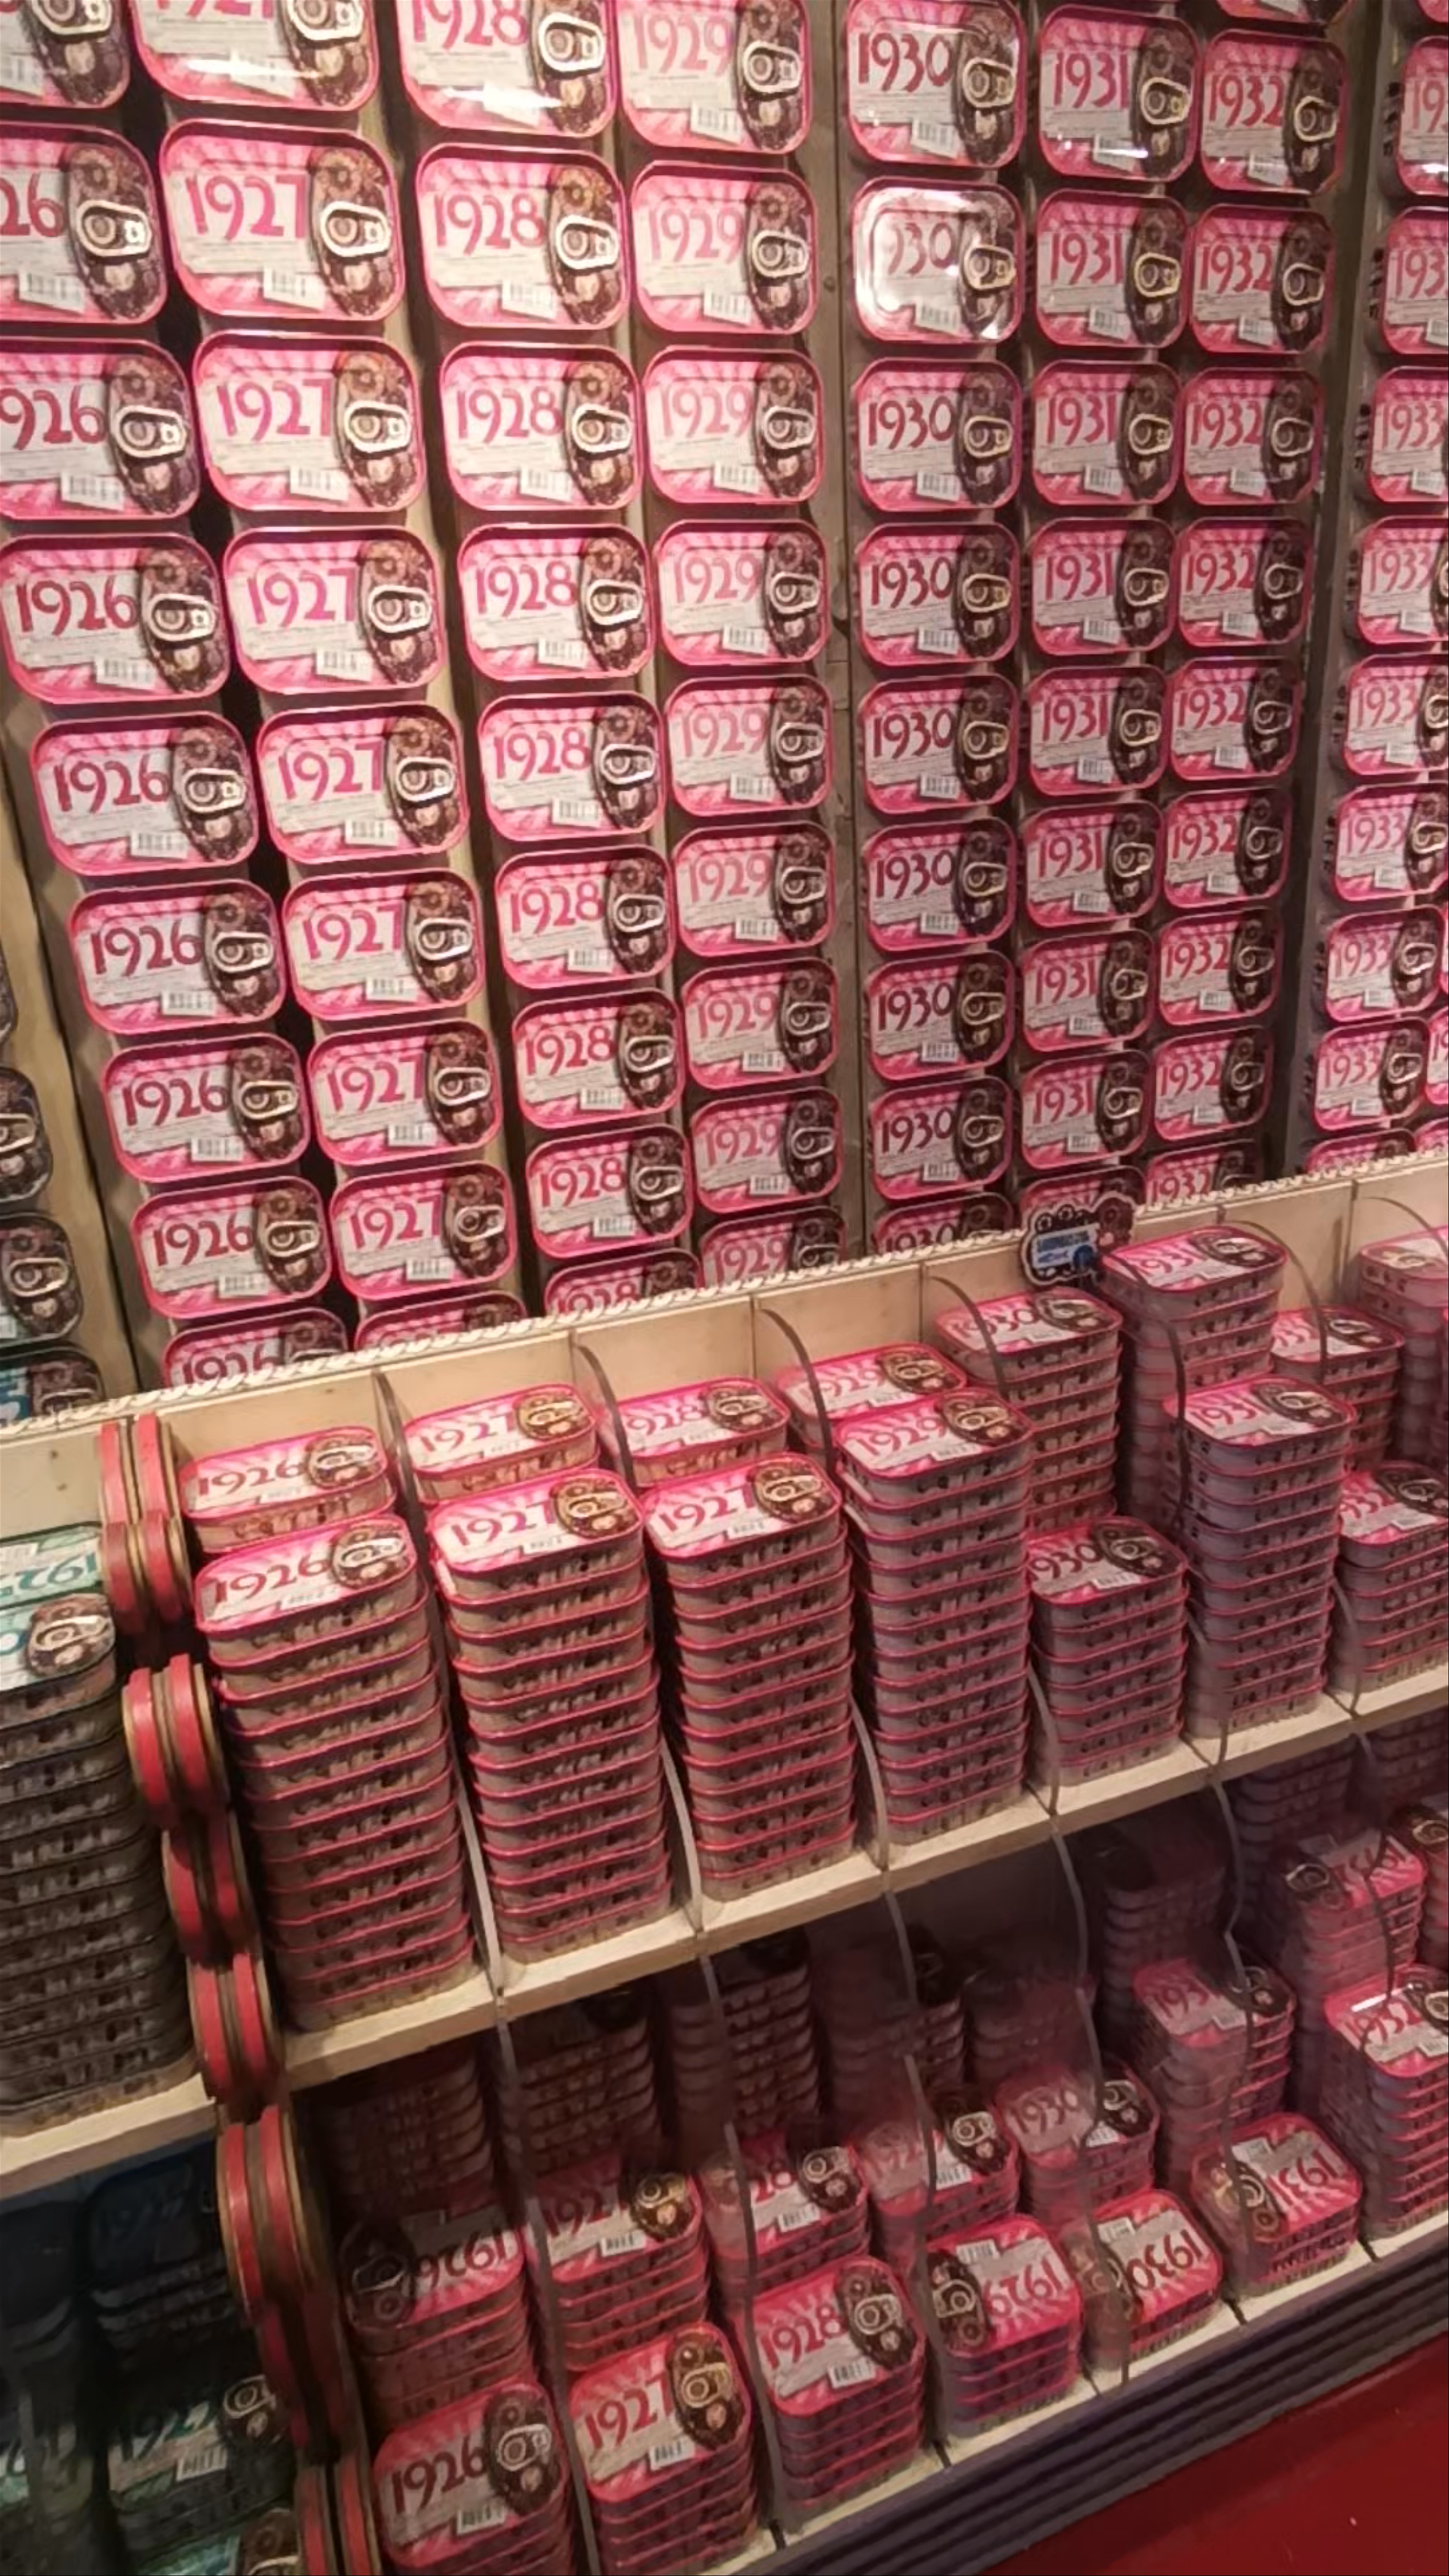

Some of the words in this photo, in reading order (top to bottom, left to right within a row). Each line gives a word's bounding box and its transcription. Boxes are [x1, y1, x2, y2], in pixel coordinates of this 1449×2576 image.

[634, 15, 733, 75] 1929
[857, 32, 955, 93] 1930
[1054, 51, 1130, 109] 1931
[1209, 75, 1283, 128] 1932
[186, 172, 306, 240] 1927
[434, 193, 545, 255] 1928
[647, 206, 744, 264] 1929
[1050, 232, 1123, 285] 1931
[1200, 243, 1273, 294] 1932
[217, 379, 332, 441] 1927
[457, 386, 562, 444] 1928
[659, 383, 752, 440] 1929
[868, 396, 955, 450] 1930
[1047, 393, 1116, 445] 1931
[1191, 401, 1263, 450] 1932
[1381, 401, 1445, 451] 1933
[475, 560, 578, 617] 1928
[674, 552, 764, 605] 1929
[871, 556, 954, 609] 1930
[1045, 551, 1113, 601] 1931
[1186, 548, 1255, 595] 1932
[1370, 547, 1432, 593] 1933
[16, 576, 138, 636] 1926
[247, 567, 357, 628] 1927
[1042, 695, 1108, 743] 1931
[1177, 685, 1246, 730] 1932
[1358, 683, 1418, 727] 1933
[493, 726, 591, 782] 1928
[681, 706, 769, 757] 1929
[874, 708, 955, 759] 1930
[53, 755, 172, 815] 1926
[278, 742, 384, 802] 1927
[1038, 830, 1103, 878] 1931
[1171, 815, 1238, 861] 1932
[1346, 811, 1406, 855] 1933
[688, 853, 773, 904] 1929
[875, 849, 954, 899] 1930
[302, 904, 403, 961] 1927
[509, 880, 604, 935] 1928
[90, 918, 204, 977] 1926
[1164, 935, 1229, 979] 1932
[1334, 930, 1393, 978] 1933
[1035, 951, 1096, 1005] 1931
[697, 990, 779, 1040] 1929
[877, 981, 956, 1032] 1930
[526, 1024, 617, 1076] 1928
[1325, 1045, 1381, 1088] 1933
[122, 1070, 228, 1127] 1926
[326, 1058, 423, 1114] 1927
[1032, 1079, 1094, 1124] 1931
[1160, 1056, 1221, 1097] 1932
[705, 1117, 784, 1168] 1929
[881, 1107, 956, 1154] 1930
[538, 1157, 627, 1207] 1928
[154, 1211, 254, 1267] 1926
[349, 1195, 444, 1250] 1927
[715, 1234, 786, 1284] 1929
[419, 1412, 518, 1453] 1927
[626, 1403, 708, 1436] 928
[855, 1413, 947, 1456] 1929
[197, 1458, 306, 1498] 1926
[450, 1502, 556, 1546] 1927
[658, 1483, 755, 1532] 1927
[214, 1553, 331, 1606] 1926
[1027, 1543, 1101, 1581] 930
[1266, 2150, 1338, 2206] 1931
[1126, 2229, 1203, 2290] 1930
[984, 2256, 1075, 2319] 1929
[761, 2302, 846, 2370] 1928
[584, 2377, 676, 2449] 1927
[391, 2436, 489, 2514] 1926
